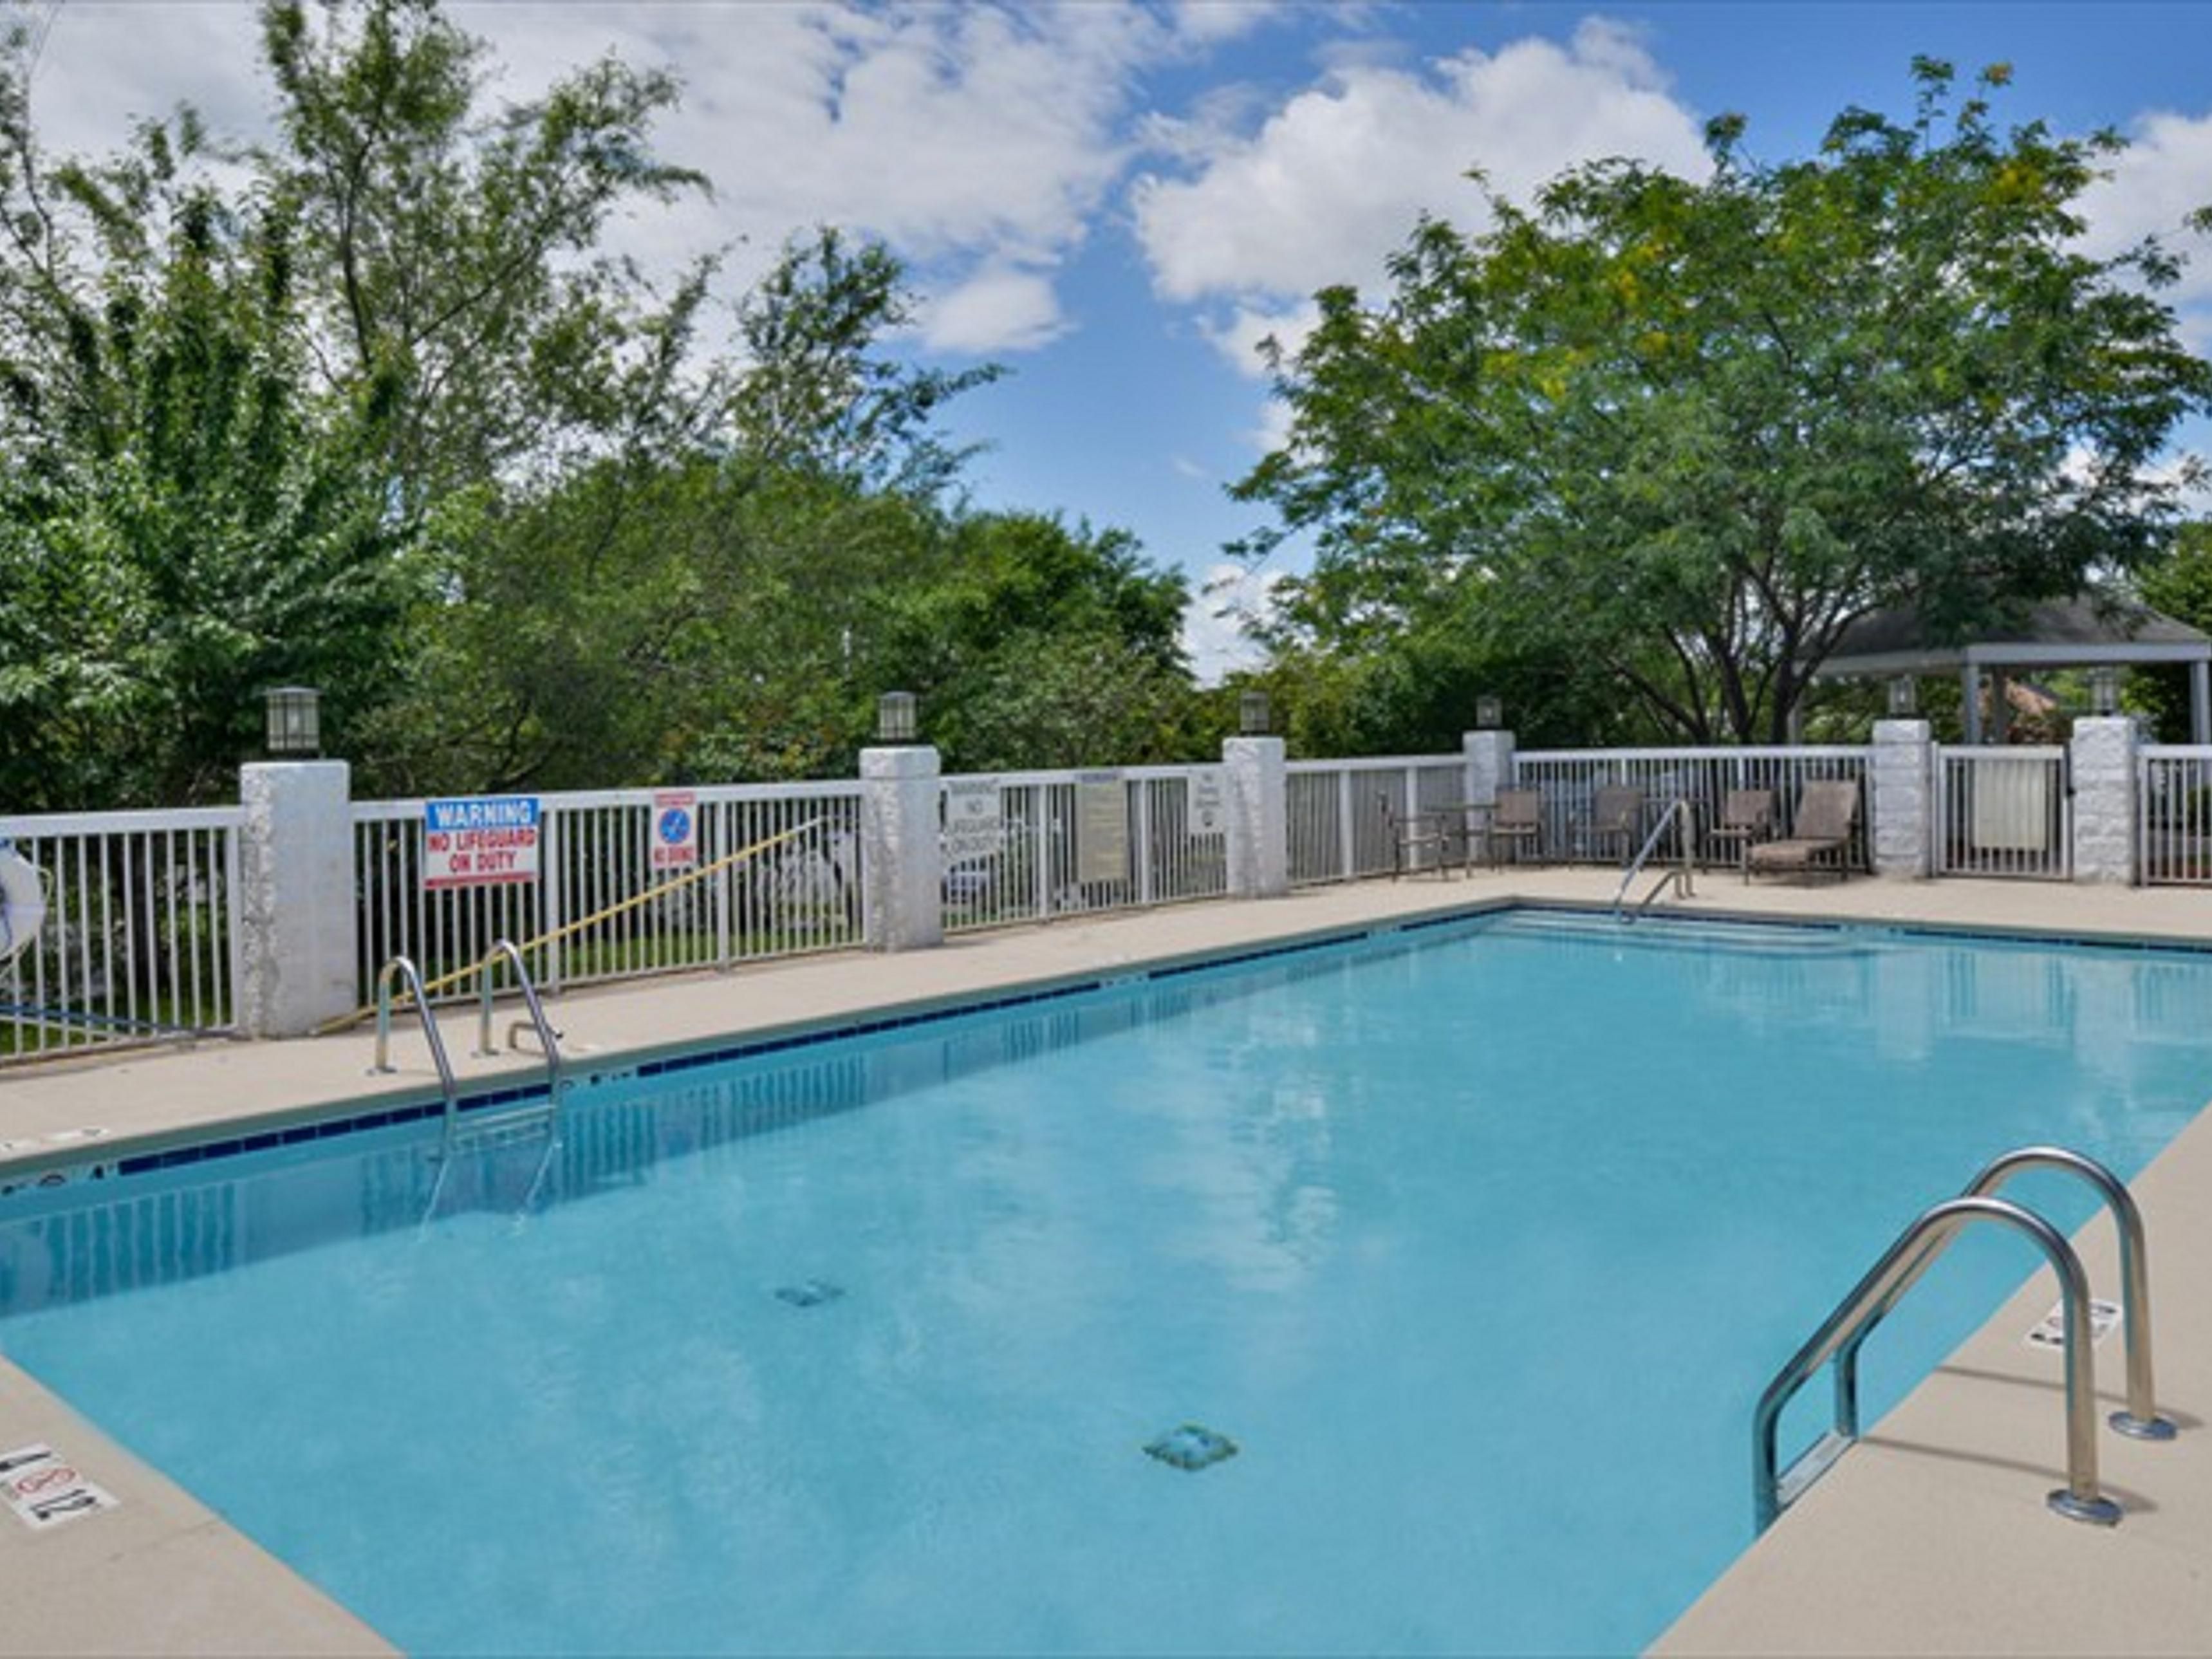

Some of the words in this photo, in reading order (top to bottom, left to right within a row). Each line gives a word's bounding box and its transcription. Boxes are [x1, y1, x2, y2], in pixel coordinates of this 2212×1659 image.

[435, 801, 532, 828] WARNING
[429, 832, 449, 851] NO
[456, 828, 535, 850] LIFEGUARD
[450, 853, 471, 873] ON
[478, 851, 516, 871] DUTY
